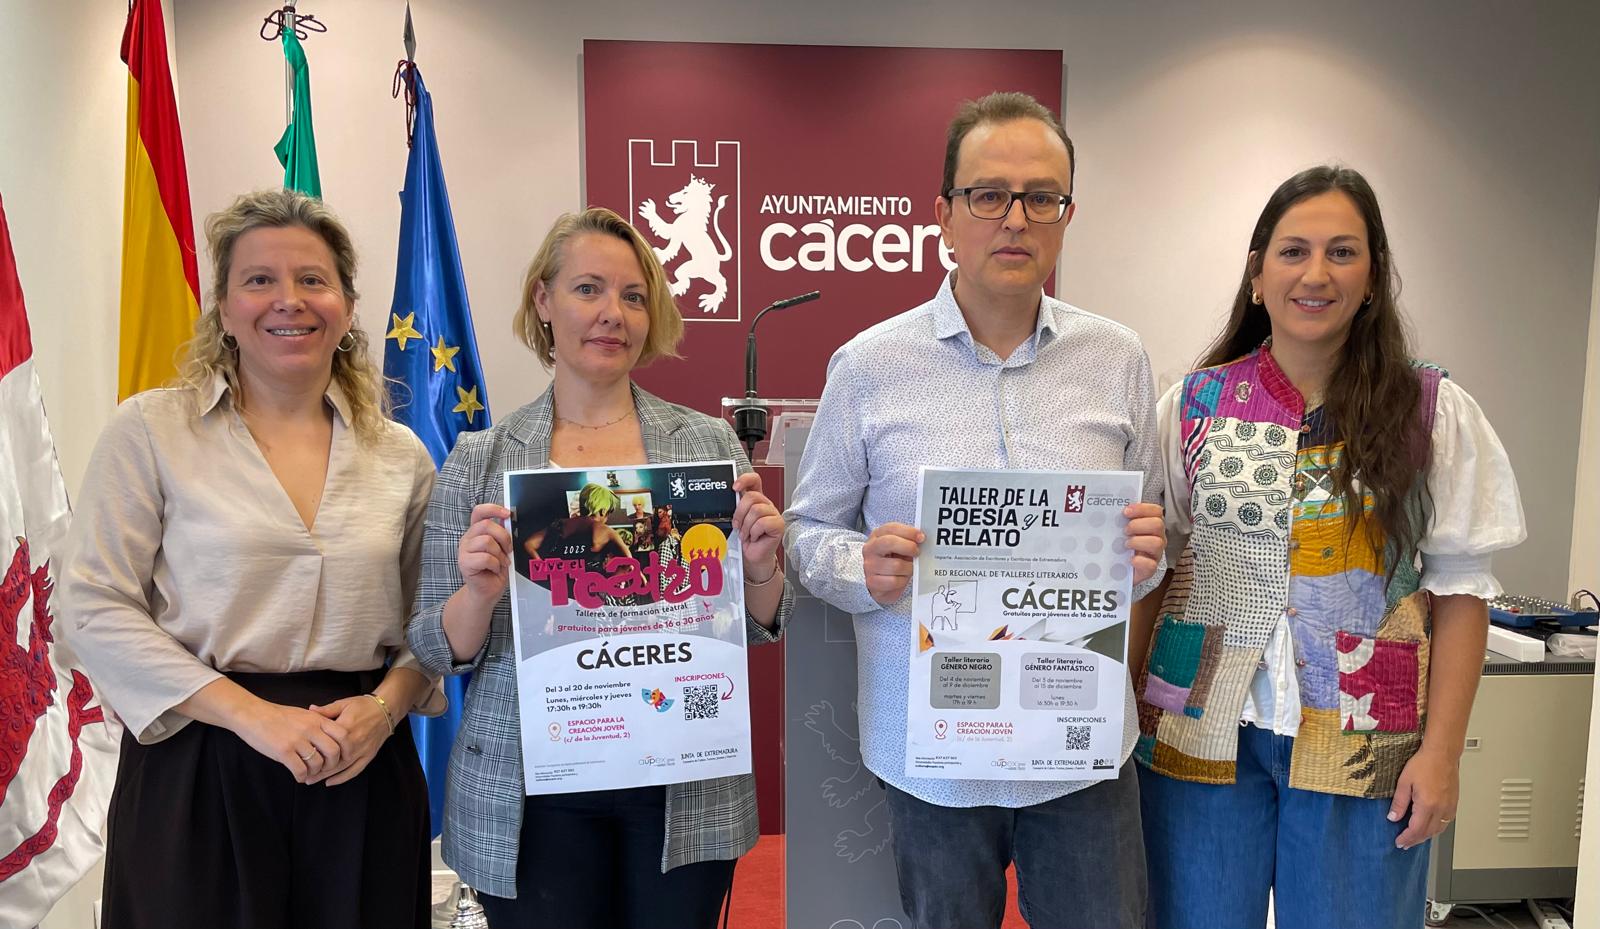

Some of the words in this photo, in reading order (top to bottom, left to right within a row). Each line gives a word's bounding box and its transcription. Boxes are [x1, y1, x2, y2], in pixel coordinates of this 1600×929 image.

[760, 195, 912, 216] AYUNTAMIENTO
[759, 218, 959, 273] cácer
[939, 486, 999, 505] TALLER
[1005, 488, 1025, 506] DE
[1029, 489, 1049, 507] LA
[938, 504, 1018, 526] POESÍA
[1021, 513, 1039, 531] y
[1042, 509, 1059, 527] EL
[936, 528, 1020, 547] RELATO
[563, 545, 586, 555] 2025
[950, 569, 987, 577] REGIONAL
[1002, 581, 1118, 611] CÁCERES
[576, 609, 605, 617] Talleres
[620, 608, 660, 619] formación
[662, 602, 688, 613] teatral
[598, 626, 618, 634] para
[620, 625, 651, 634] jóvenes
[683, 616, 693, 625] 30
[695, 613, 714, 623] años
[576, 641, 693, 670] CÁCERES
[1057, 657, 1083, 665] literario
[941, 662, 968, 670] GÉNERO
[1025, 662, 1052, 671] GÉNERO
[1053, 662, 1095, 672] FANTÁSTICO
[674, 672, 725, 683] INSCRIPCIONES
[565, 684, 571, 692] al
[594, 681, 631, 689] noviembre
[570, 693, 603, 702] miércoles
[610, 692, 632, 701] jueves
[569, 725, 602, 734] CREACIÓN
[603, 724, 625, 732] JOVEN
[591, 732, 622, 741] Juventud,
[624, 731, 631, 739] 2)
[704, 747, 738, 757] EXTREMADURA
